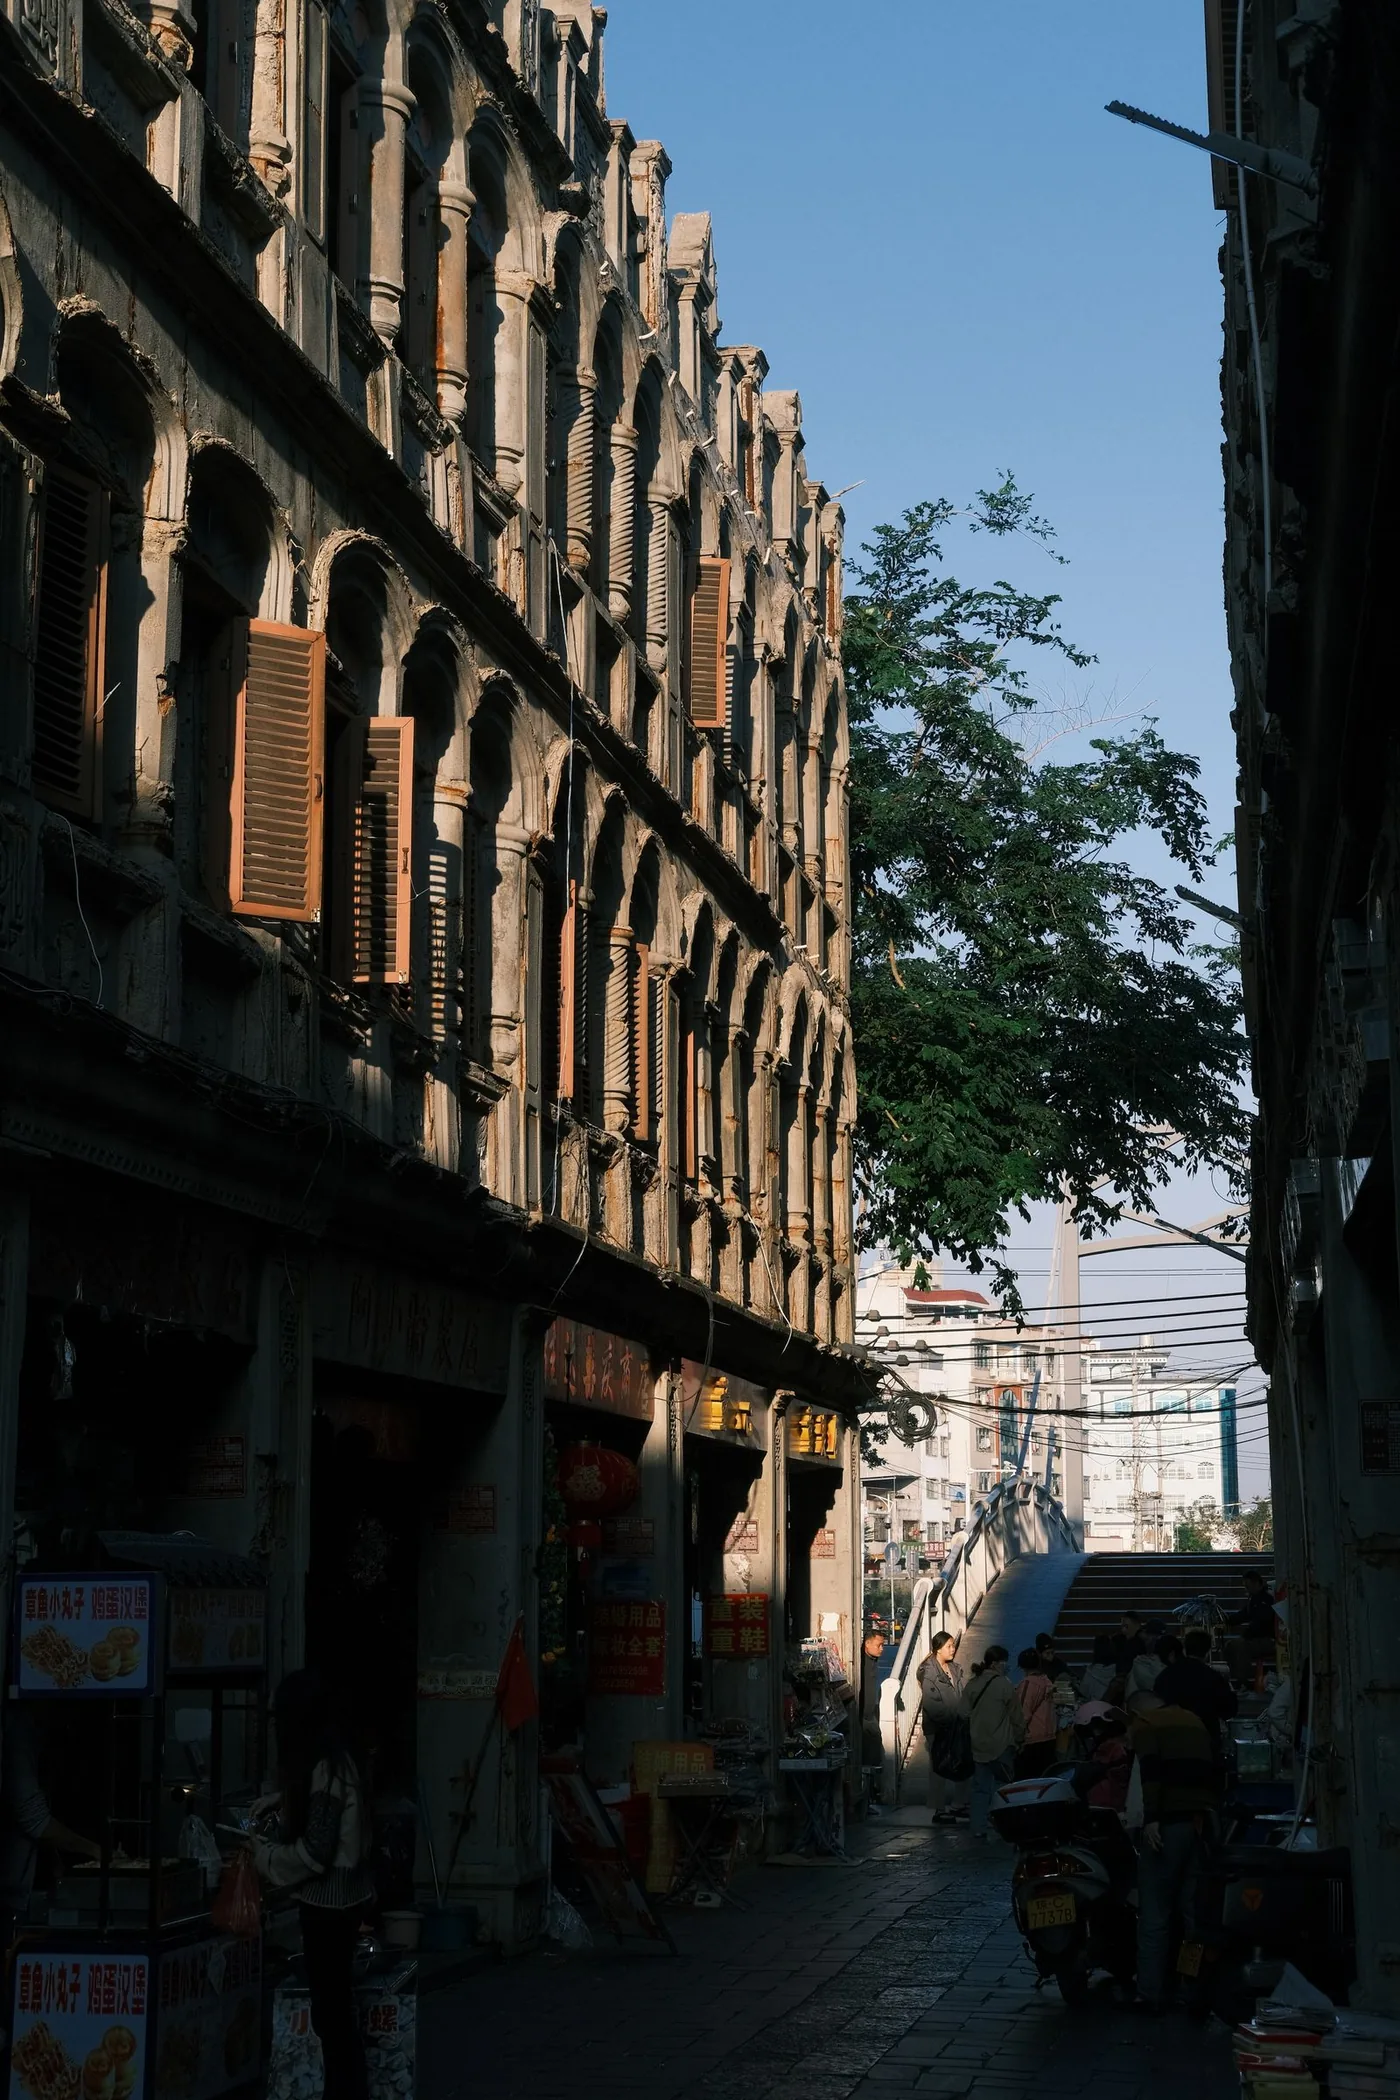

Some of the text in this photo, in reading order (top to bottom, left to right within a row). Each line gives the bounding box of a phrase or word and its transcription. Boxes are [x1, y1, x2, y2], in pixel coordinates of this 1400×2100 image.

[91, 1586, 147, 1621] 鸡蛋汉堡
[708, 1596, 764, 1621] 童装
[708, 1626, 766, 1652] 童鞋
[87, 1962, 146, 2014] 鸡蛋汉堡
